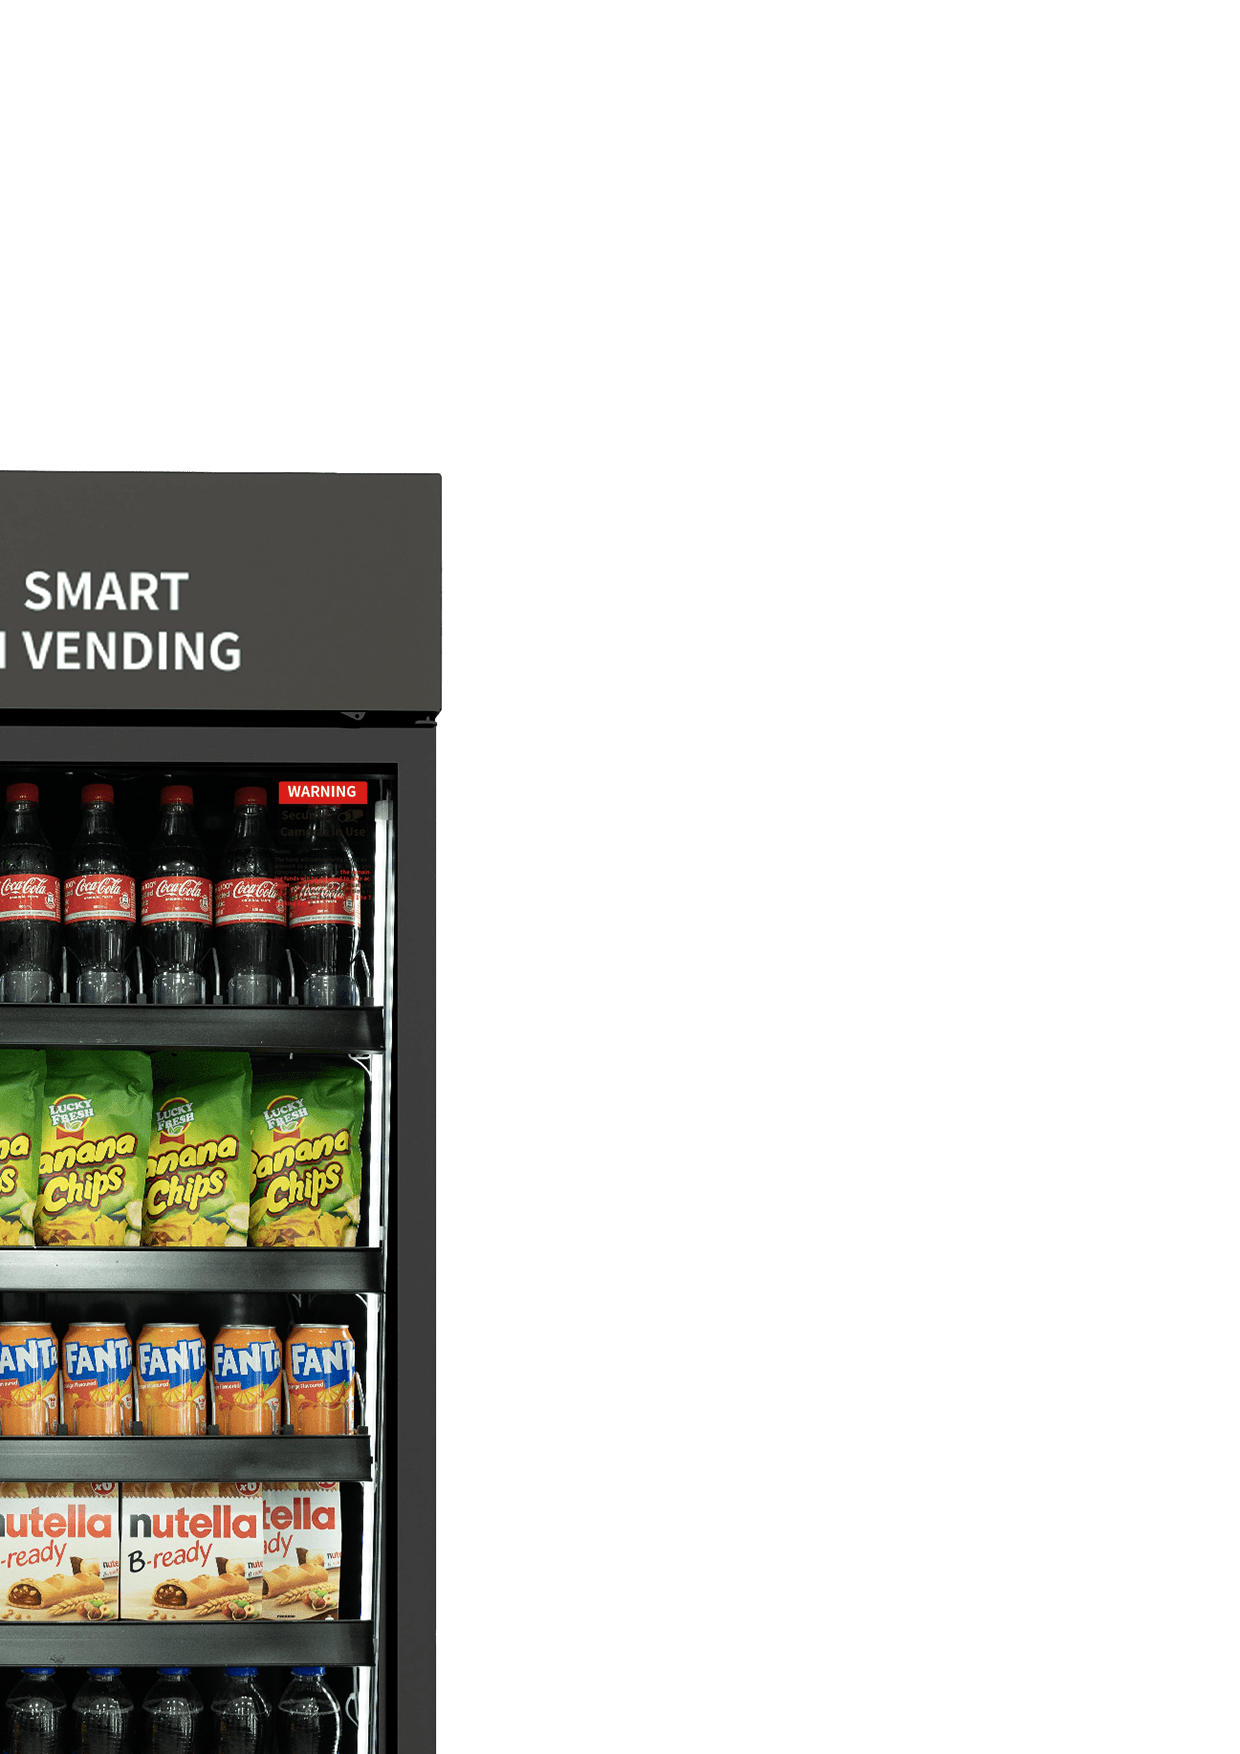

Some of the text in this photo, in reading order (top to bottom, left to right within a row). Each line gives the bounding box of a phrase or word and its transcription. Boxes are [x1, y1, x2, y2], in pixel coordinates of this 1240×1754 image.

[25, 571, 189, 610] SMART
[24, 632, 241, 671] VENDING
[288, 785, 356, 798] WARNING
[282, 809, 327, 822] Security
[280, 826, 366, 838] Cameras In Use
[1, 877, 48, 896] Coca-Cola
[75, 877, 123, 896] Coca-Cola
[156, 879, 204, 897] Coca-Cola
[233, 880, 278, 898] Coca-Cola
[49, 1099, 92, 1116] LUCKY
[50, 1108, 95, 1126] FRESH
[156, 1103, 193, 1121] LUCKY
[263, 1099, 304, 1120] LUCKY
[157, 1112, 195, 1132] FRESH
[265, 1108, 308, 1130] FRESH
[41, 1164, 126, 1215] Chips
[146, 1167, 227, 1218] Chips
[265, 1161, 343, 1215] Chips
[291, 1340, 355, 1376] FANT
[130, 1505, 257, 1539] nutella
[262, 1497, 336, 1530] tella
[102, 1560, 119, 1569] nute
[127, 1539, 213, 1573] B-ready
[247, 1559, 263, 1569] nute
